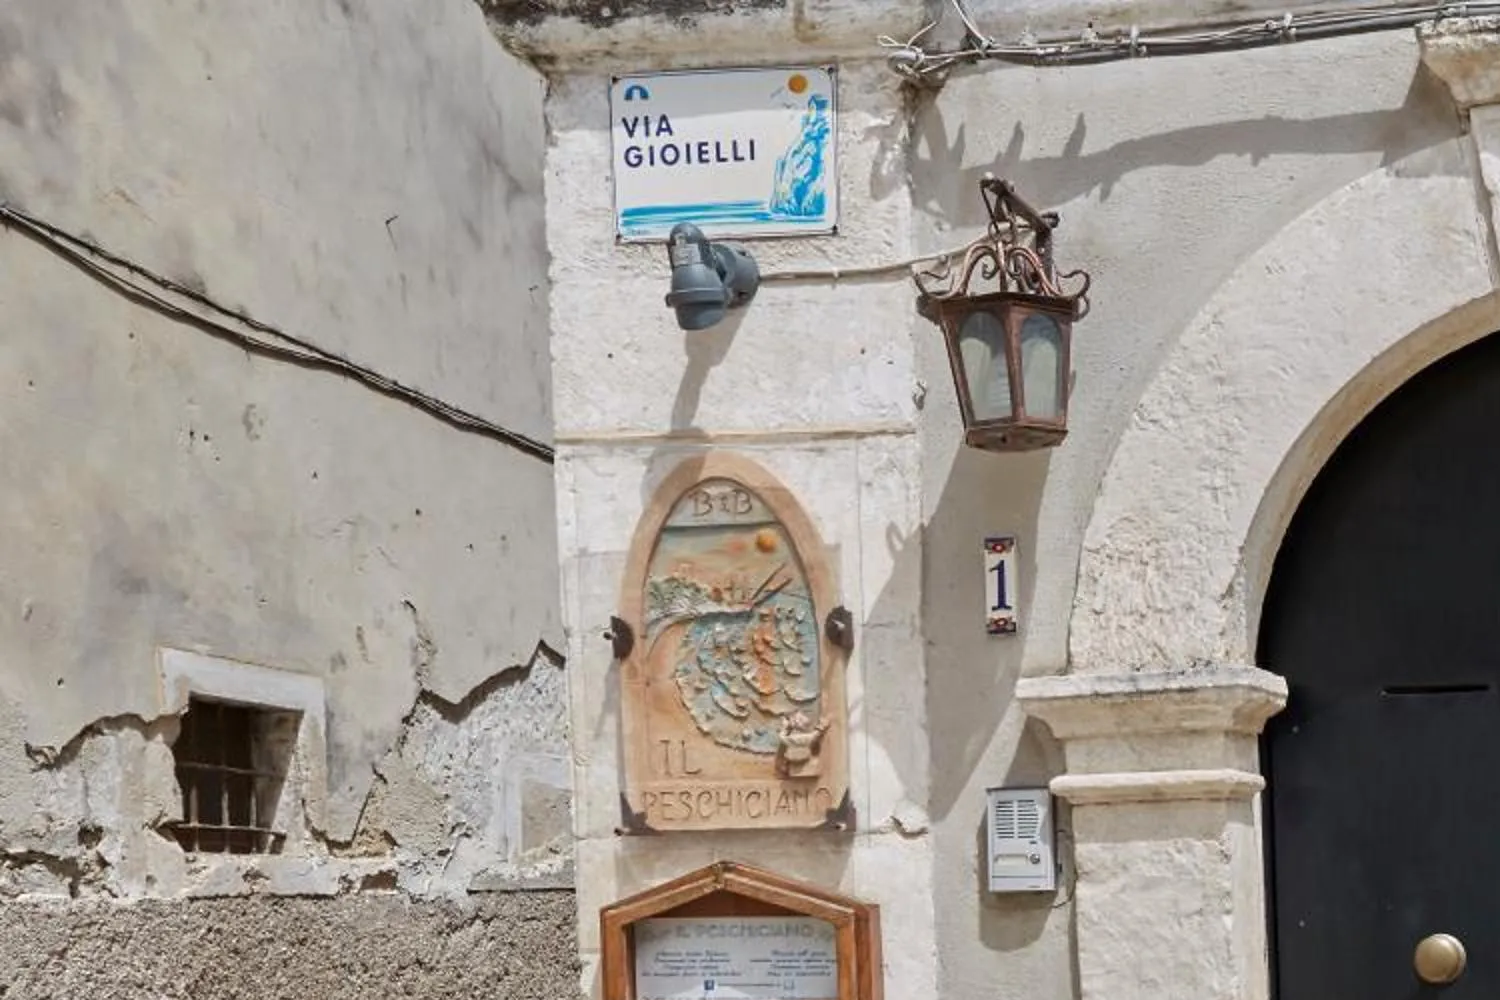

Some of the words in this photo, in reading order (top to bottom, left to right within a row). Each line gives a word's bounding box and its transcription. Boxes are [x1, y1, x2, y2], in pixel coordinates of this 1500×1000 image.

[622, 114, 673, 138] VIA
[624, 140, 755, 168] GIOIELLI
[690, 488, 753, 517] B&B
[988, 559, 1012, 611] 1
[659, 739, 703, 777] IL
[641, 786, 832, 821] PESCHICIANO
